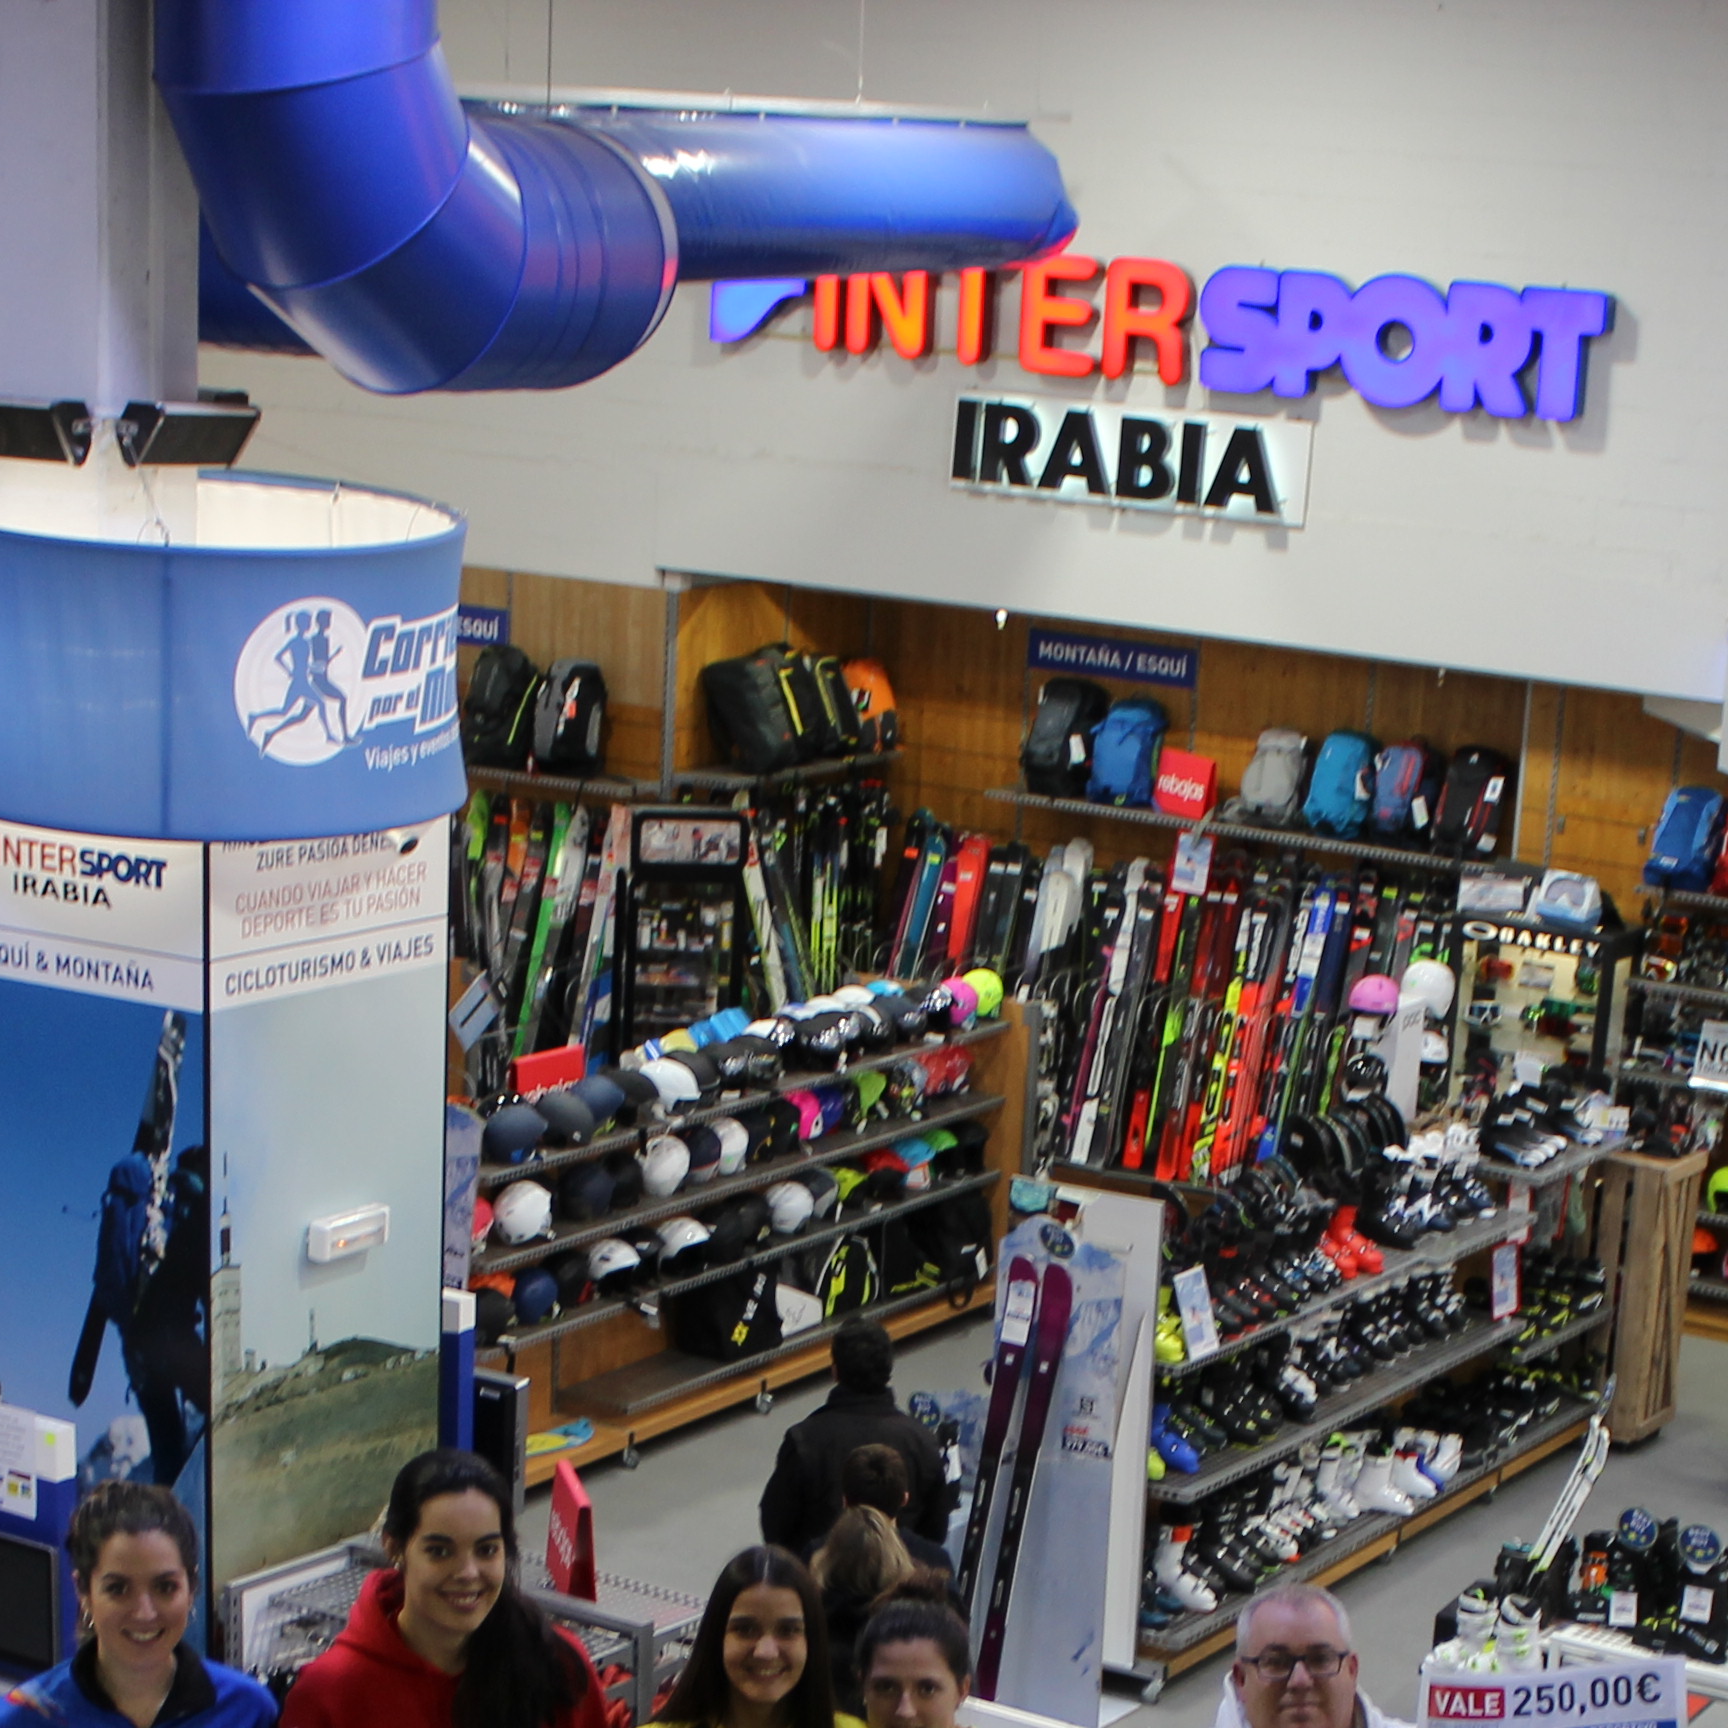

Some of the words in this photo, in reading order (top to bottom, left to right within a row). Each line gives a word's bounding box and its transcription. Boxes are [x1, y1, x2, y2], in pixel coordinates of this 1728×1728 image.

[953, 400, 1276, 515] IRABIA
[1038, 640, 1121, 669] MONTAÑA
[1136, 653, 1188, 678] ESQUÍ
[365, 743, 409, 772] Viajes
[257, 845, 293, 871] ZURE
[13, 871, 112, 909] IRABIA
[235, 882, 303, 915] CUANDO
[308, 873, 360, 901] VIAJAR
[376, 861, 427, 885] HACER
[241, 906, 316, 939] DEPORTE
[320, 902, 340, 925] ES
[344, 898, 364, 919] TU
[367, 887, 421, 914] PASIÓN
[35, 950, 49, 973] &
[56, 953, 154, 992] MONTAÑA
[225, 950, 356, 996] CICLOTURISMO
[360, 947, 371, 969] &
[376, 933, 434, 966] VIAJES
[1435, 1690, 1501, 1716] VALE
[1512, 1673, 1661, 1718] 250,00€
